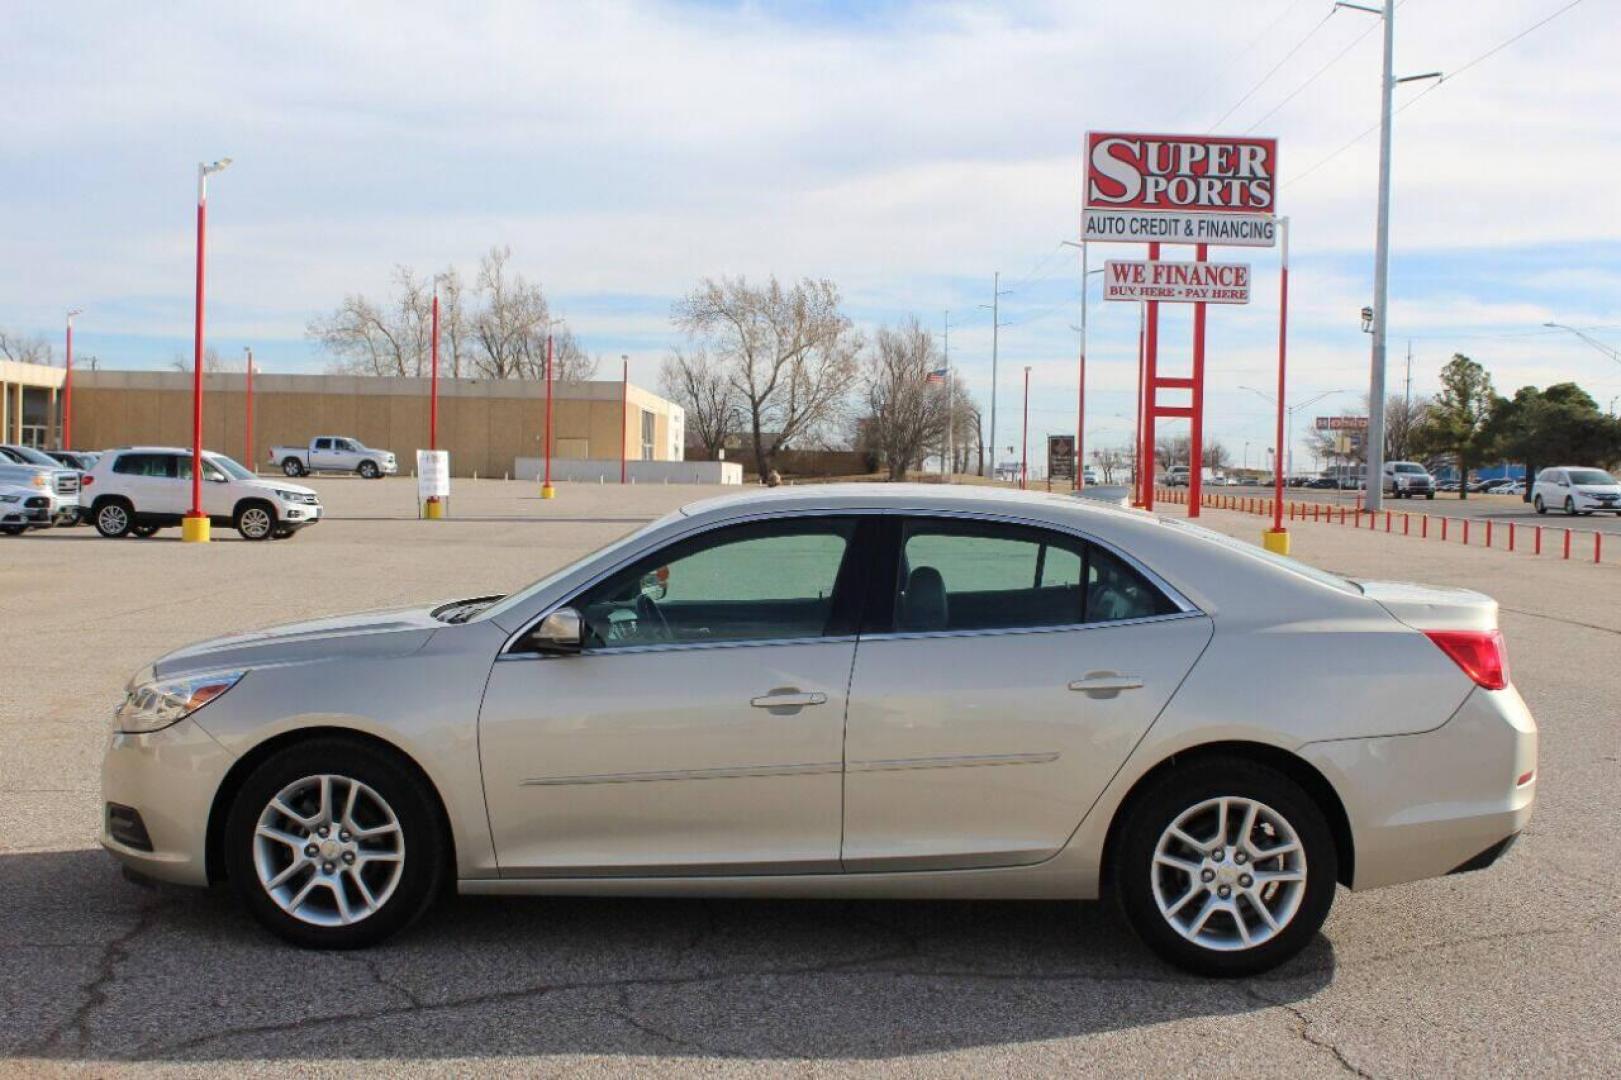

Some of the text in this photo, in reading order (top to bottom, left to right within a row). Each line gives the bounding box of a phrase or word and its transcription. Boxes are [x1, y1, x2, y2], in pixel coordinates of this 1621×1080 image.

[1091, 138, 1270, 203] SUPER
[1086, 217, 1274, 239] AUTO CREDIT & FINANCING
[1111, 262, 1247, 287] WE FINANCE
[1109, 286, 1248, 300] BUY HERE PAY HERE
